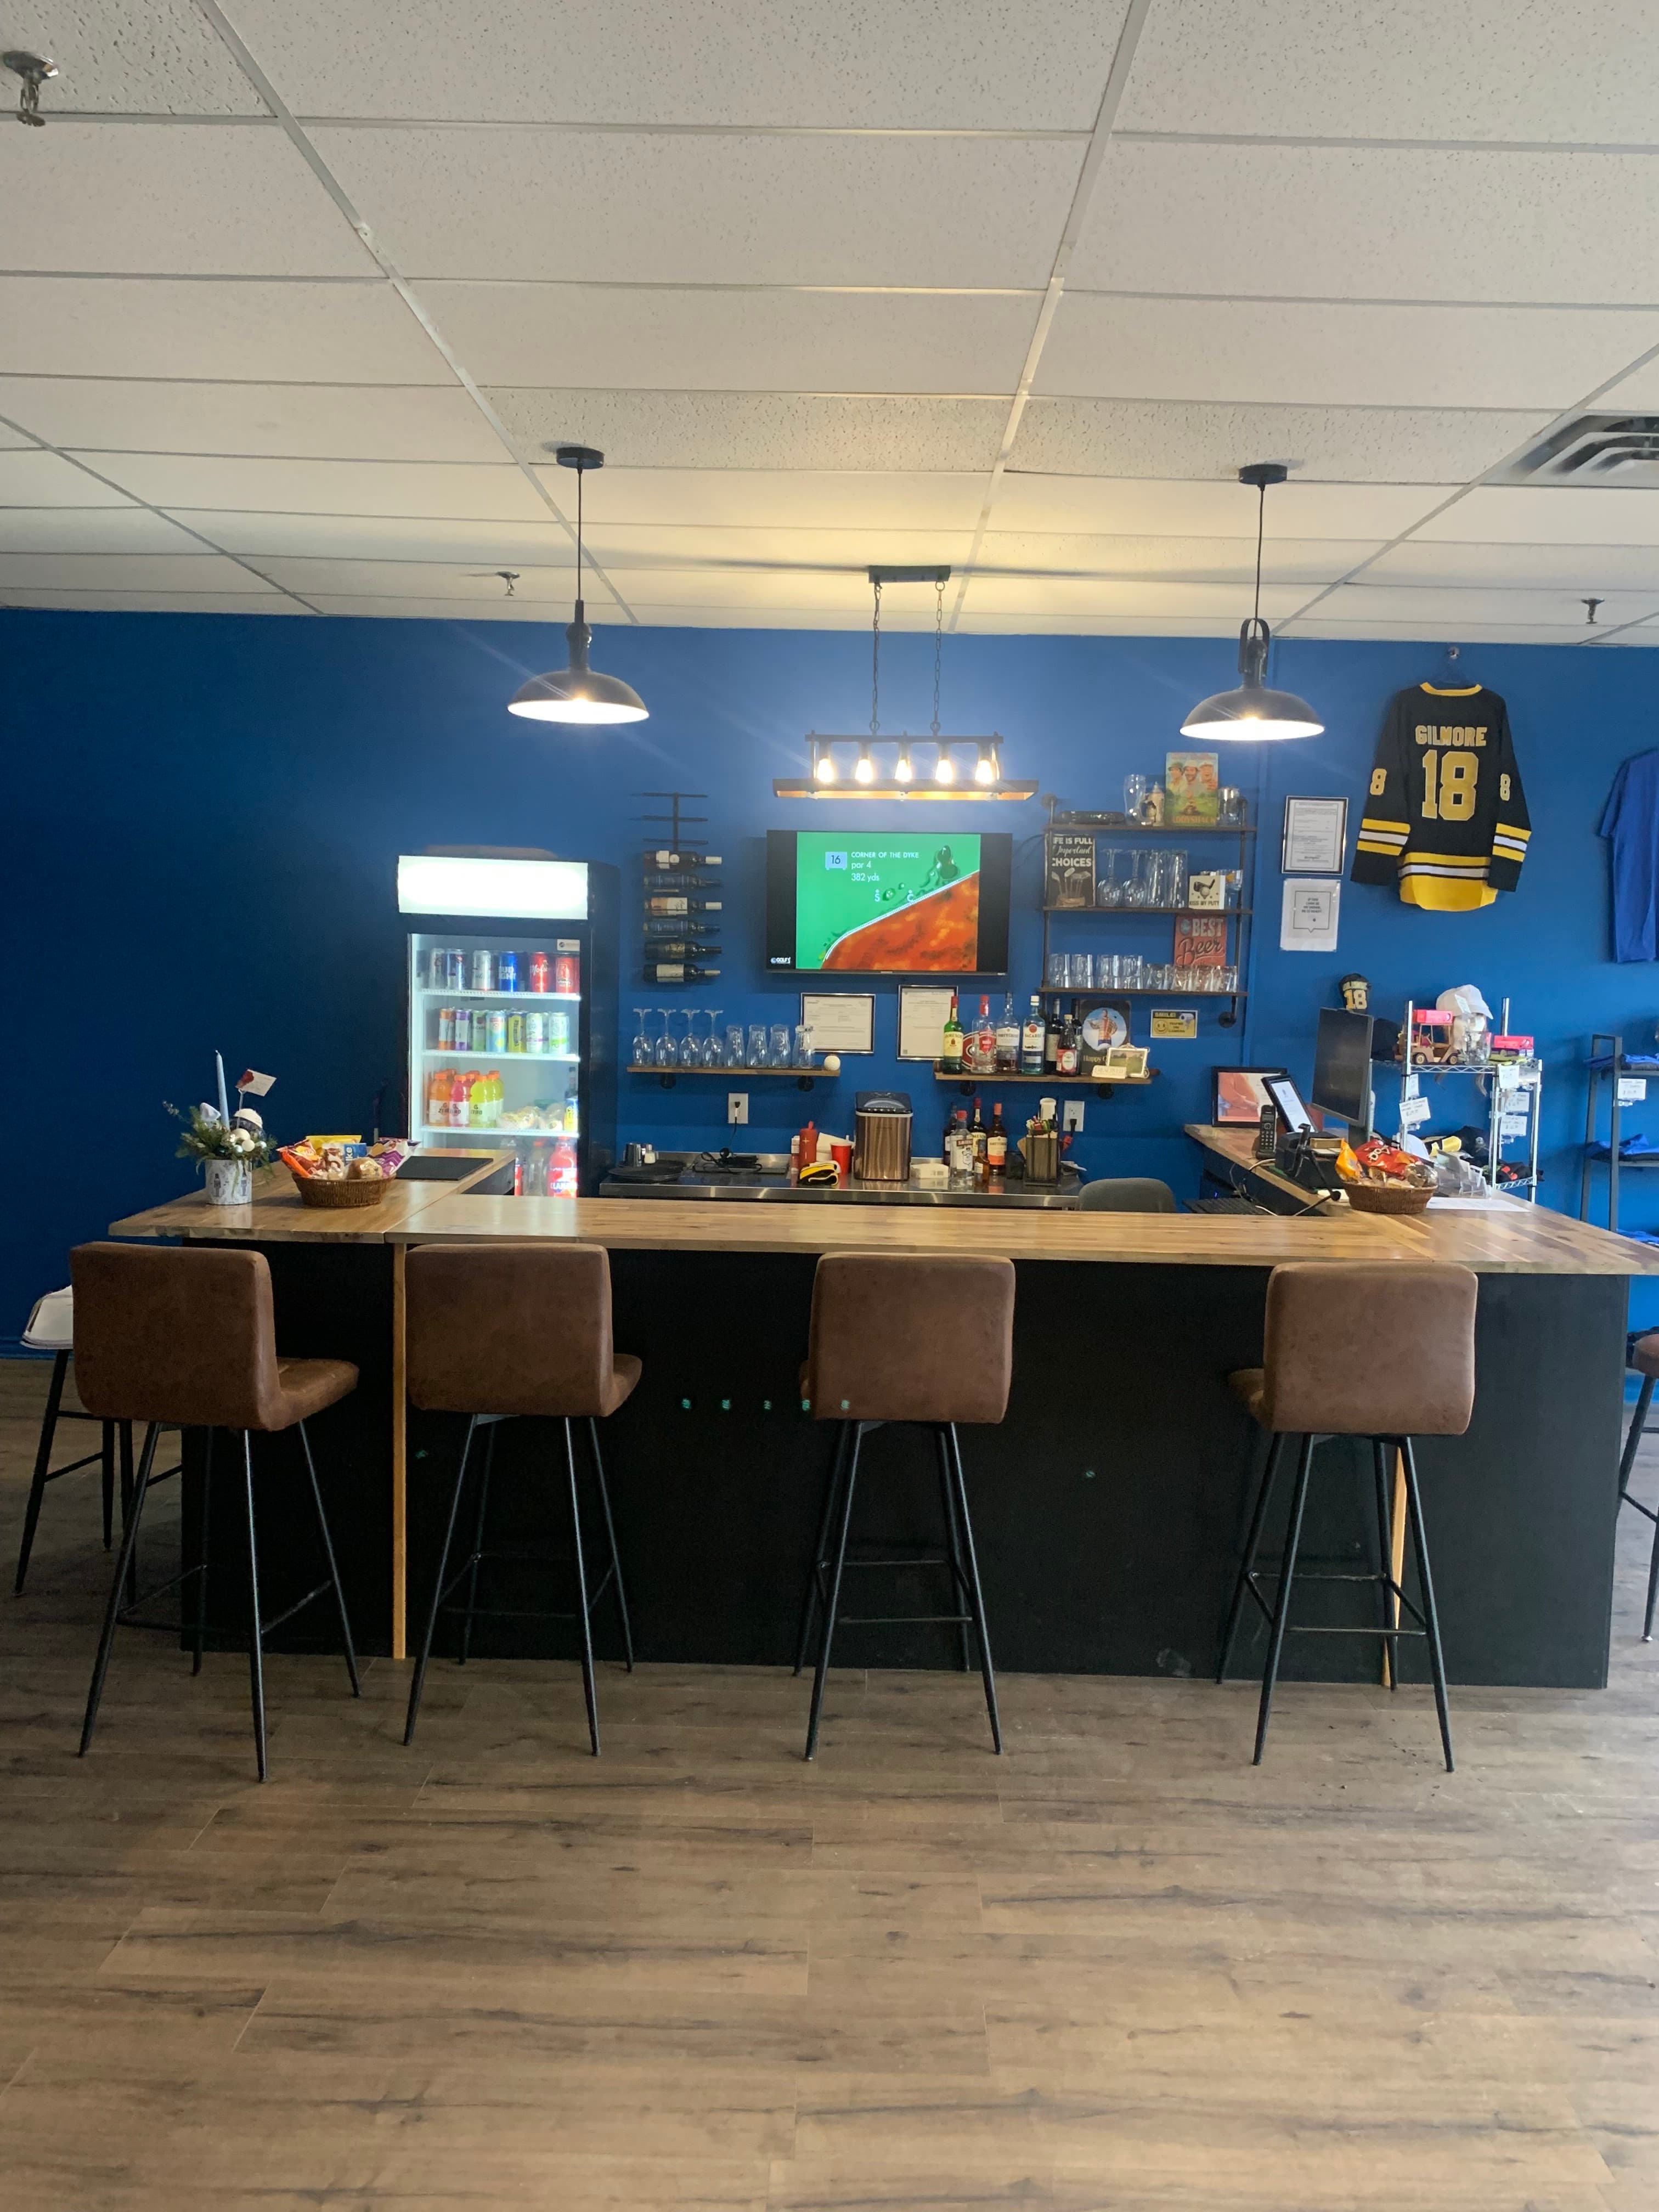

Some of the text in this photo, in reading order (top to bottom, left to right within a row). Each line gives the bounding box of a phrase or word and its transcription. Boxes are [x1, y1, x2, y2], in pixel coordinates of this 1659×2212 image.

[1415, 725, 1487, 747] GILMORE
[1422, 749, 1479, 821] 18
[831, 855, 841, 865] 16
[866, 861, 871, 869] 4
[851, 873, 880, 883] 382 yds
[1192, 918, 1223, 937] BEST
[1176, 937, 1223, 969] Beer
[1344, 989, 1367, 1009] 18
[1083, 1054, 1099, 1063] Happy
